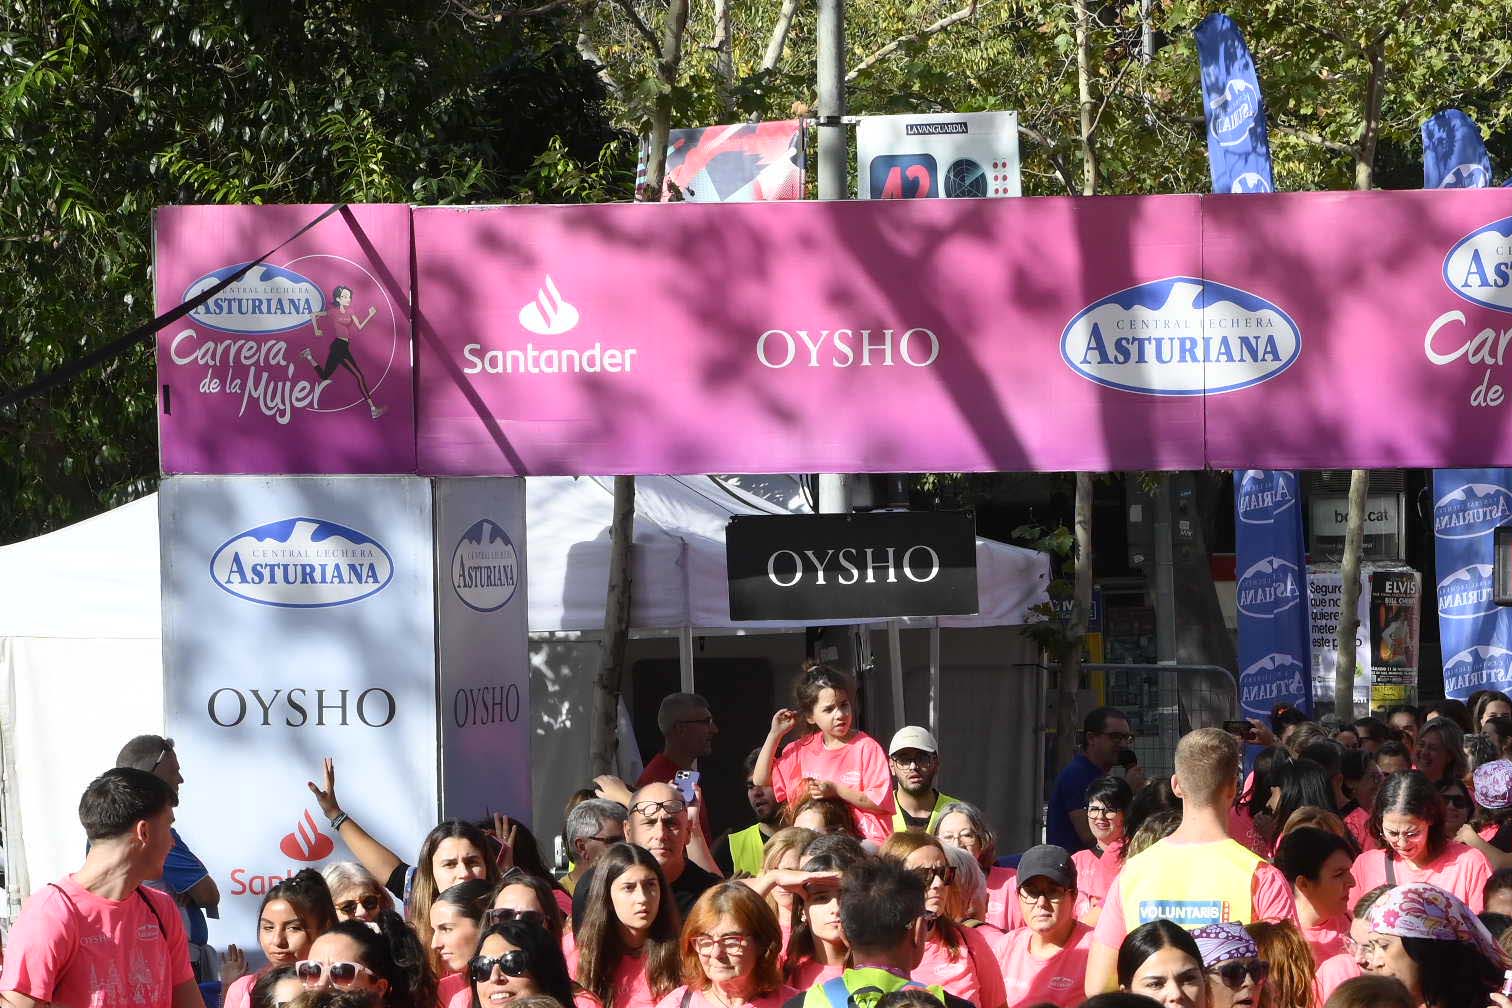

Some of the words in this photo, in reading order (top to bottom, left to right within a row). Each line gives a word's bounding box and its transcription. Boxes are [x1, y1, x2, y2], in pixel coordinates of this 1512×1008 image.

[194, 297, 313, 315] ASTURIANA
[1115, 318, 1190, 330] CENTRAL
[1200, 316, 1274, 329] LECHERA
[171, 329, 288, 366] Carrera
[463, 342, 636, 374] Santander
[756, 328, 939, 368] OYSHO
[1080, 322, 1282, 365] ASTURIANA
[200, 368, 220, 393] de
[226, 368, 241, 393] la
[239, 362, 332, 425] Mujer
[1470, 367, 1504, 407] de
[225, 551, 380, 585] ASTURIANA
[252, 549, 310, 557] CENTRAL
[317, 549, 374, 557] LECHERA
[767, 545, 940, 587] OYSHO
[457, 555, 515, 589] ASTURIANA
[1385, 581, 1416, 594] ELVIS
[207, 687, 397, 728] OYSHO
[454, 683, 520, 728] OYSHO
